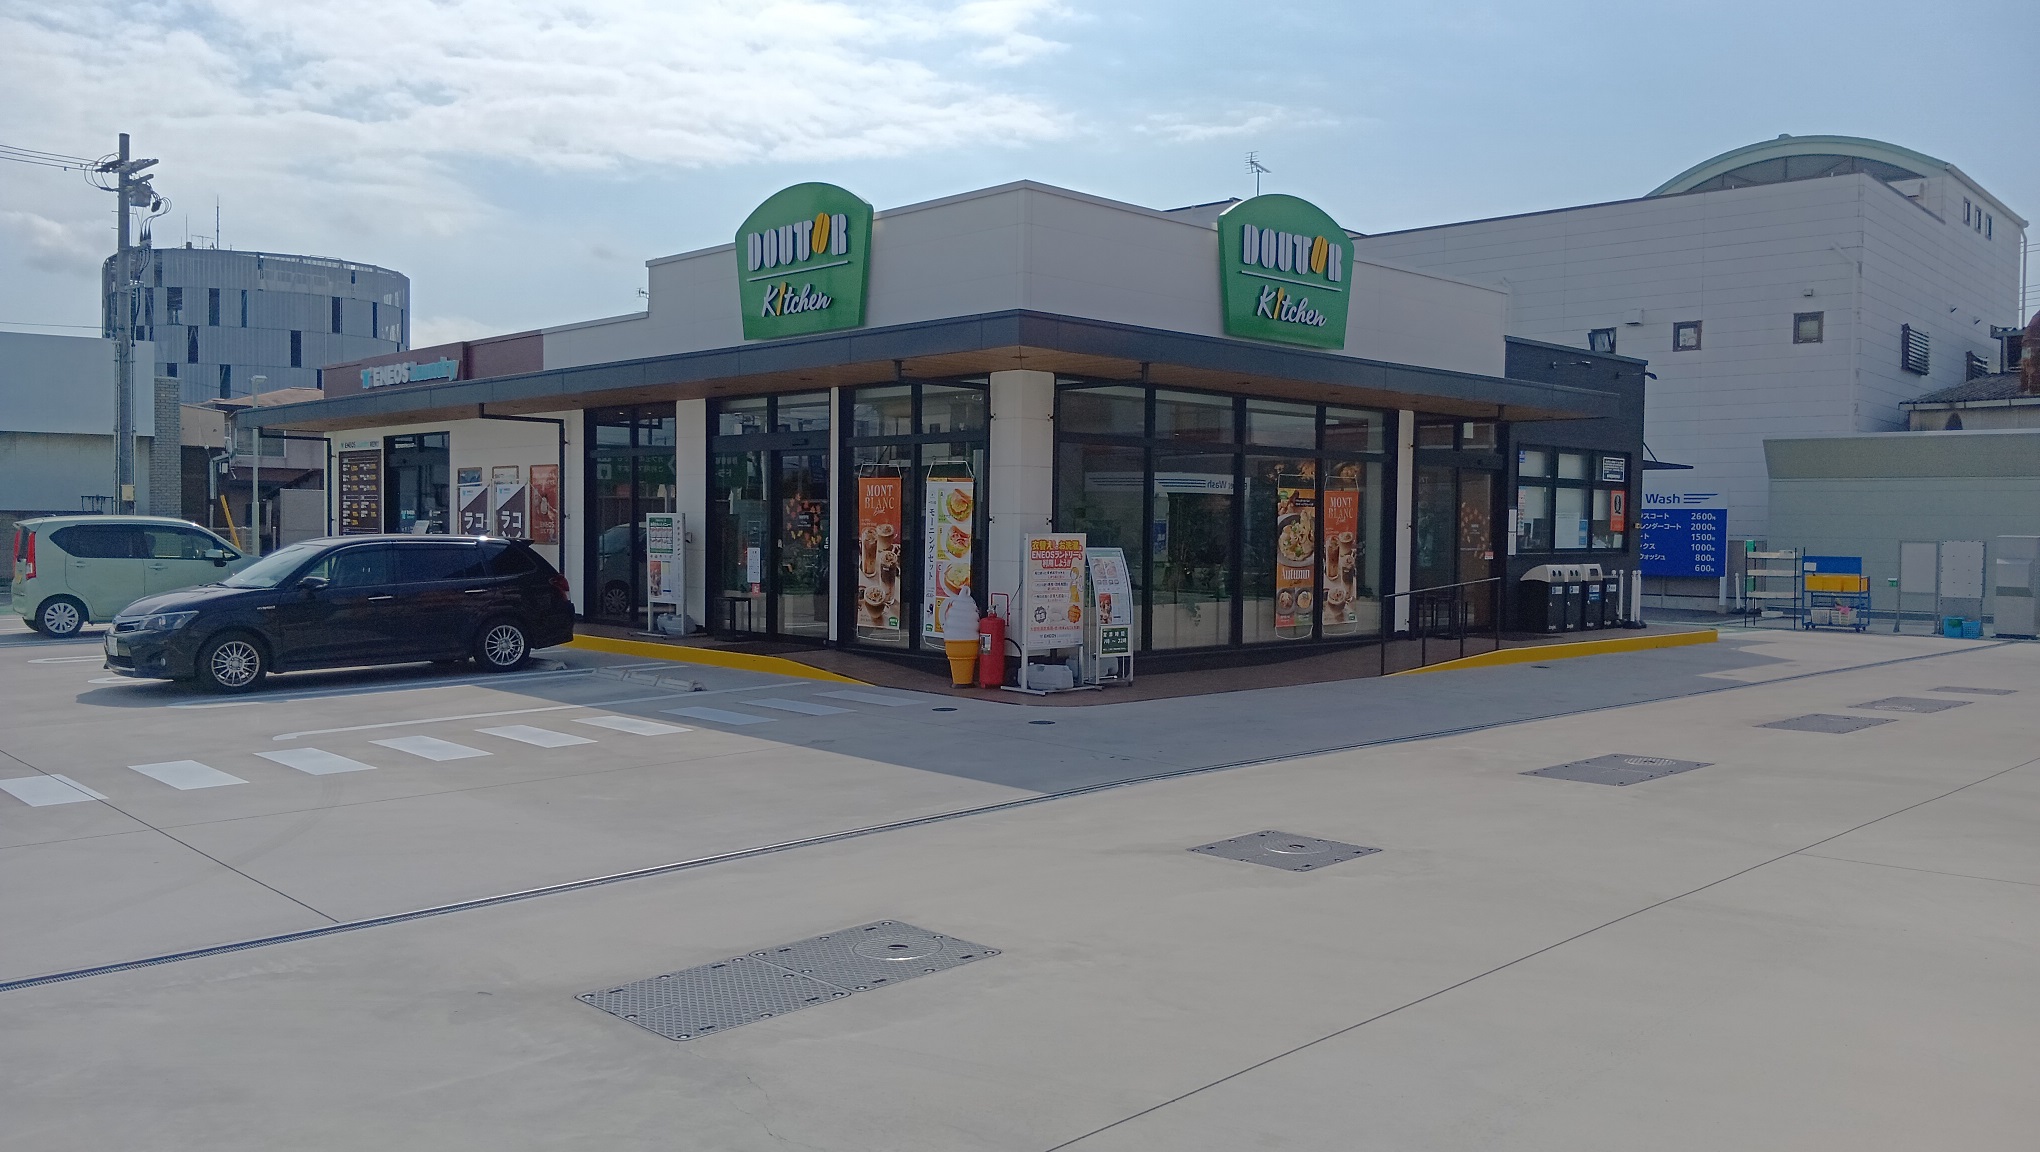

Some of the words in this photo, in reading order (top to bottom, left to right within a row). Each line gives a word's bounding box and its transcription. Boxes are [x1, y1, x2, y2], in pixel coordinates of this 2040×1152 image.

[747, 212, 848, 272] DOUTOR
[1243, 223, 1342, 282] DOUTOR
[761, 281, 832, 317] Kitchen
[1256, 284, 1327, 327] Kitchen
[373, 361, 410, 387] ENEOS
[866, 484, 894, 497] MONT
[864, 497, 895, 509] BLANC
[1330, 497, 1353, 508] MONT
[1645, 493, 1681, 504] Wash
[1328, 508, 1353, 519] BLANC
[1640, 512, 1670, 520] スコート
[1282, 567, 1310, 580] Autumn
